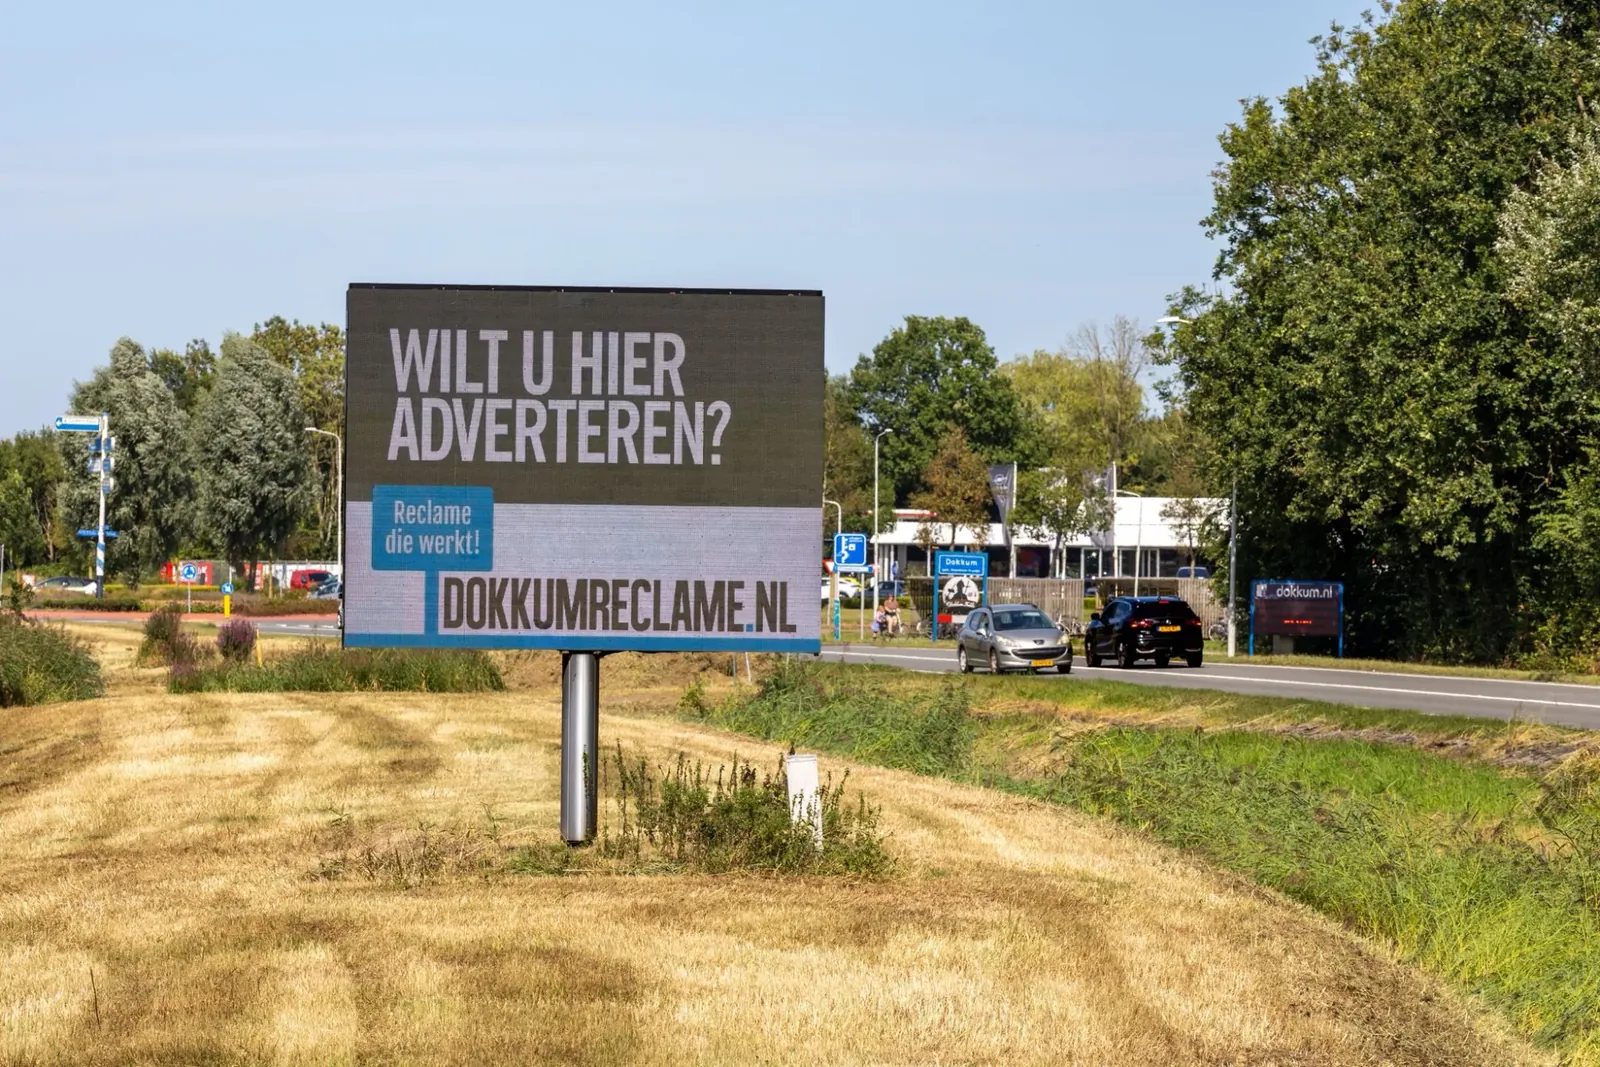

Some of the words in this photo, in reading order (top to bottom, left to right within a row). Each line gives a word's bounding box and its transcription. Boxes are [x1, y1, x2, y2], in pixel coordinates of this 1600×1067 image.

[389, 327, 508, 394] WILT
[522, 330, 554, 396] U
[571, 330, 686, 397] HIER
[387, 397, 732, 466] ADVERTEREN?
[394, 500, 471, 526] Reclame
[385, 528, 416, 555] die
[418, 530, 480, 556] werkt!
[945, 558, 978, 566] Dokkum
[443, 576, 797, 634] DOKKUMRECLAME.NL
[1276, 584, 1333, 599] dokkum.nl
